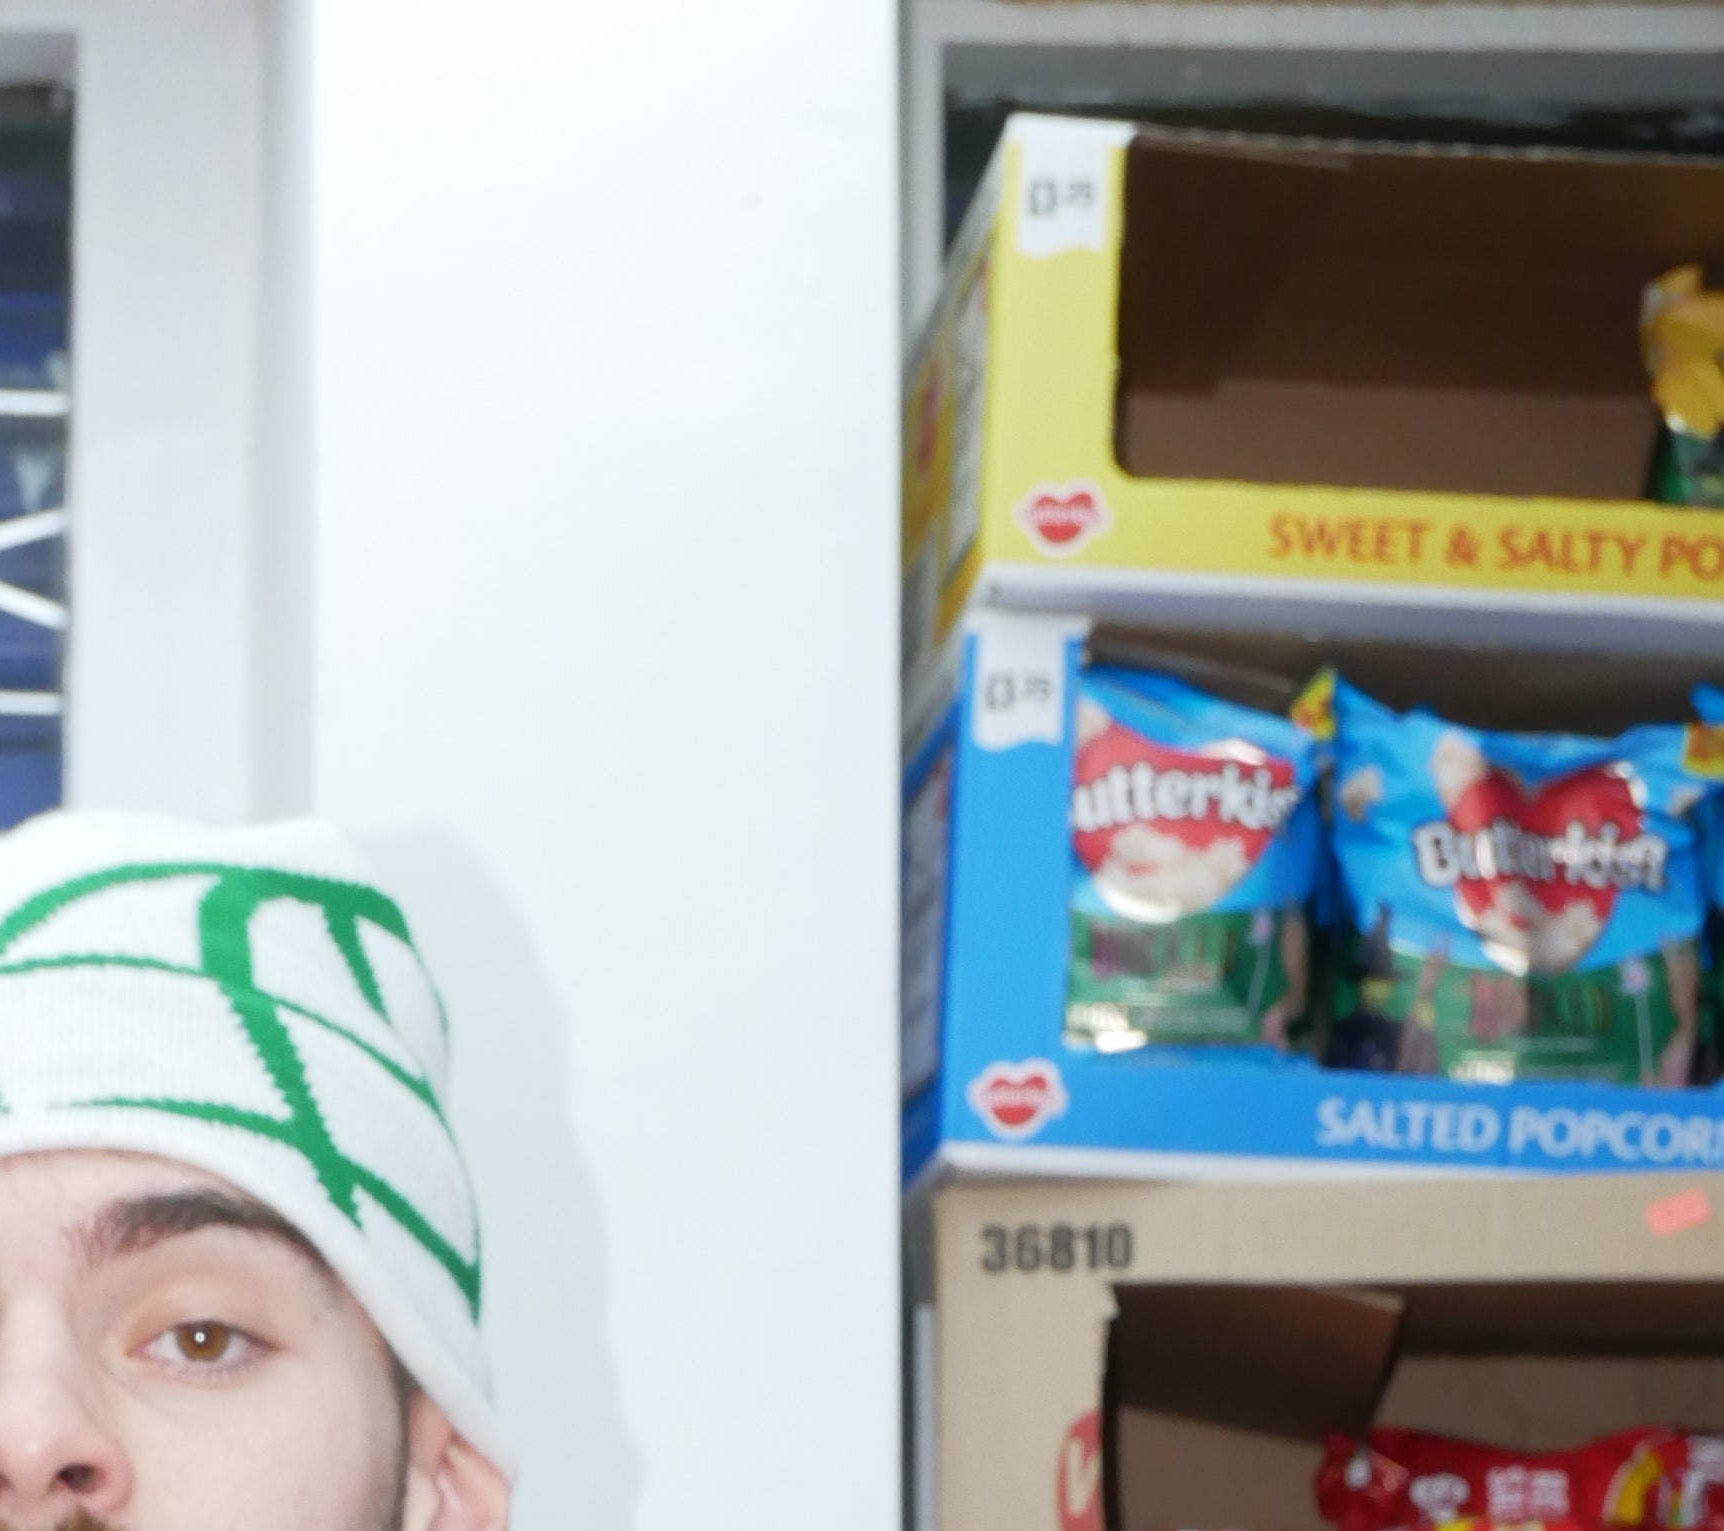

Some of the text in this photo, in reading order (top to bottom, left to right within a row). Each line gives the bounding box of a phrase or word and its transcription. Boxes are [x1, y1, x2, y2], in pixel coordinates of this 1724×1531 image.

[1268, 511, 1428, 564] SWEET
[1444, 522, 1478, 568] &
[1497, 524, 1648, 577] SALTY
[1316, 1096, 1501, 1153] SALTED
[980, 1221, 1136, 1273] 36810
